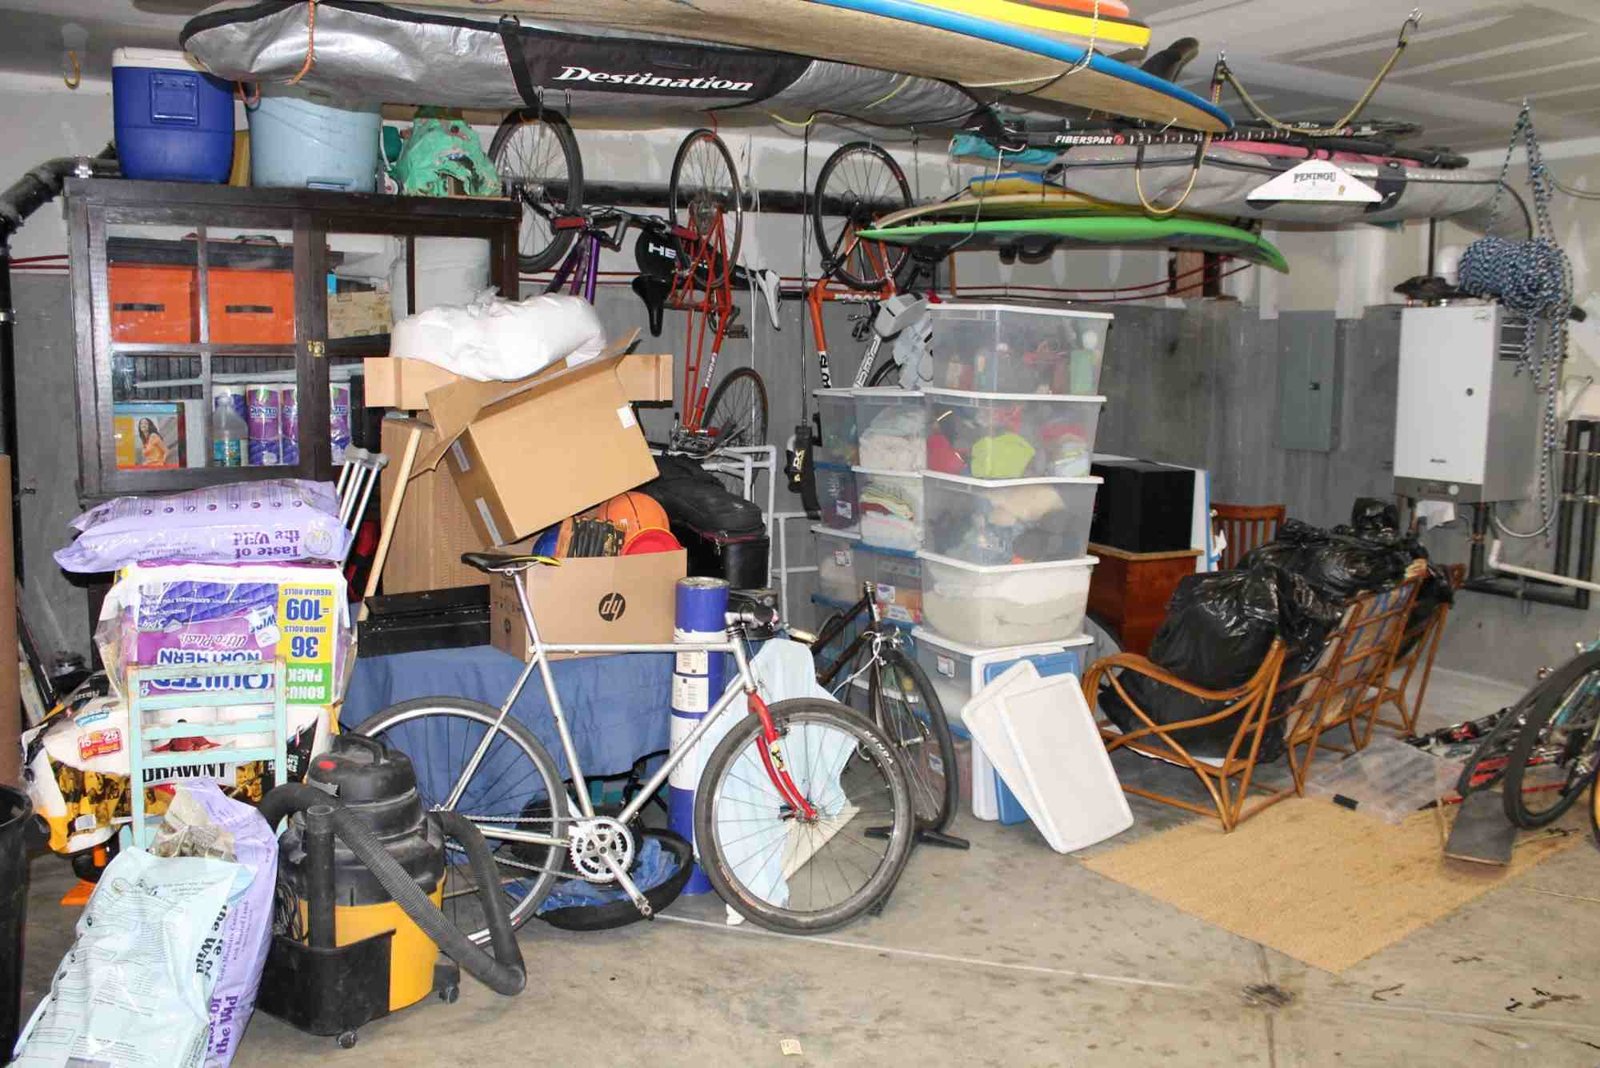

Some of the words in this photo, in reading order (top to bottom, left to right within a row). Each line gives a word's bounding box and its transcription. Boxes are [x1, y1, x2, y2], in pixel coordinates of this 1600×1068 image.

[553, 66, 753, 91] Destination
[1055, 134, 1113, 144] FIBERSPAR
[250, 407, 277, 415] QUTED
[236, 546, 252, 559] of
[256, 547, 301, 558] Taste
[284, 588, 304, 596] ROLLS
[180, 633, 213, 648] Plush
[214, 634, 247, 648] Ultra
[291, 636, 319, 658] 36
[160, 650, 259, 664] NORTHERN
[287, 668, 323, 682] PACK
[286, 686, 325, 699] BONU
[215, 1027, 232, 1055] the
